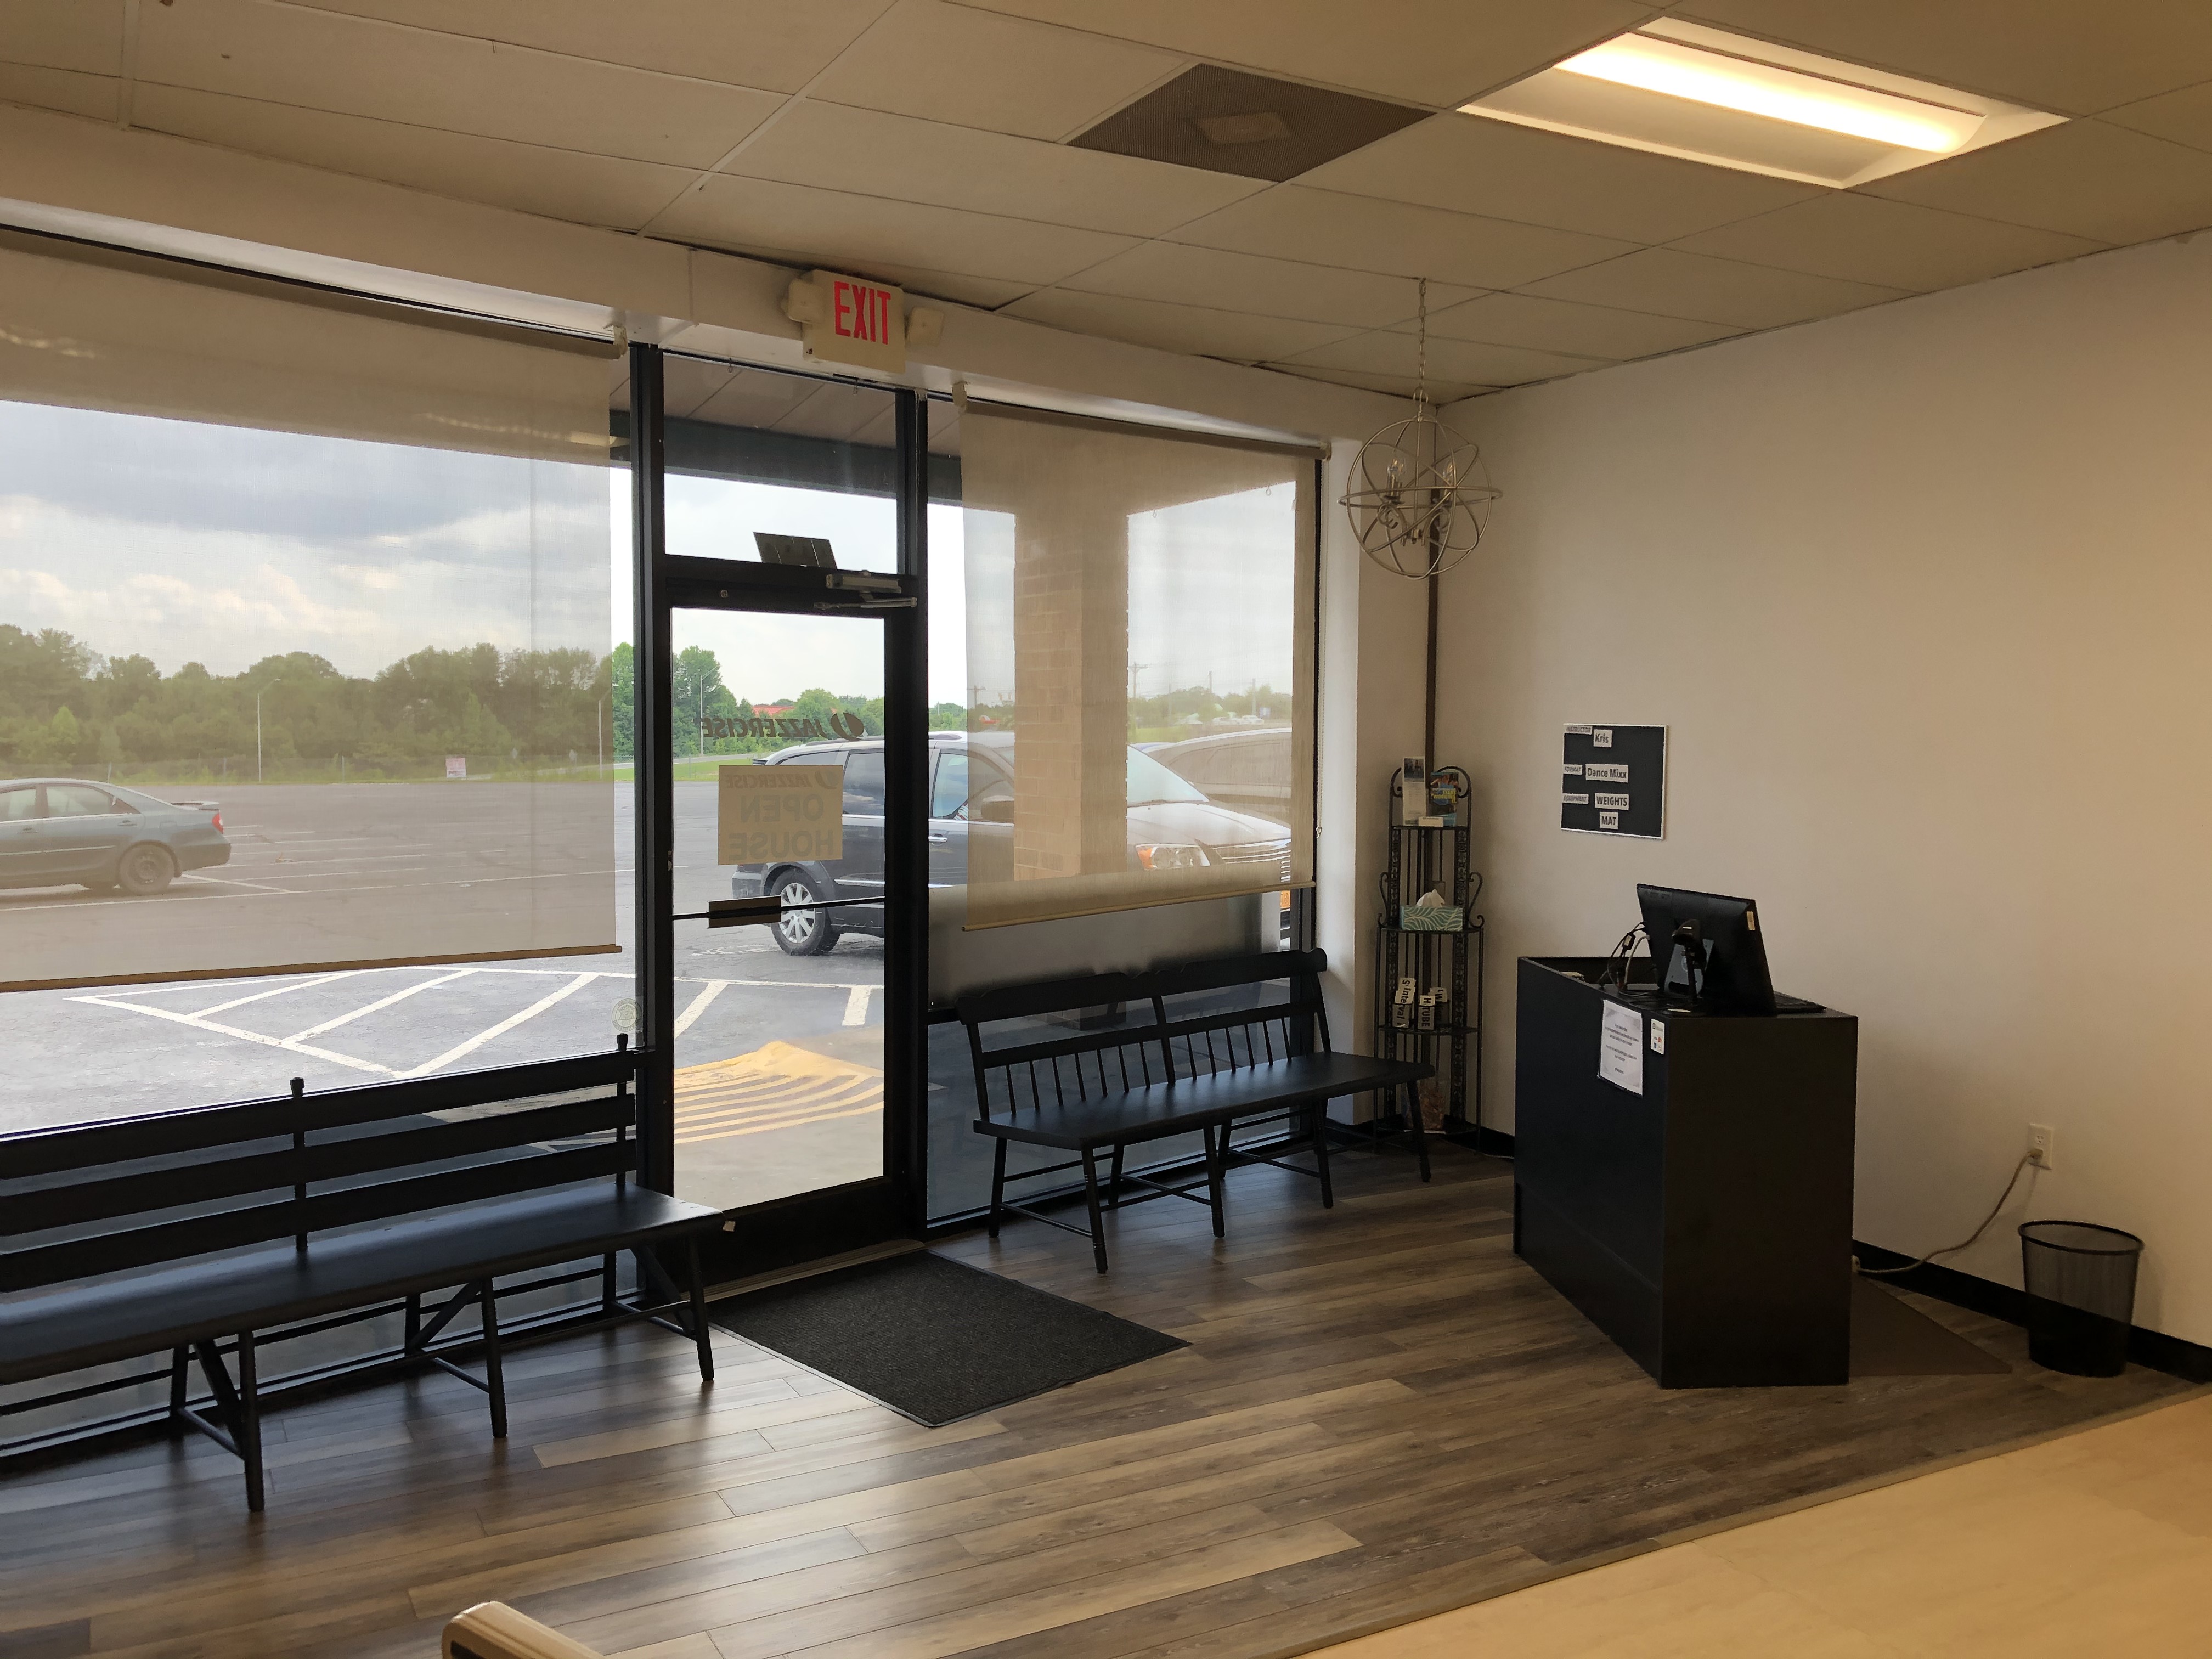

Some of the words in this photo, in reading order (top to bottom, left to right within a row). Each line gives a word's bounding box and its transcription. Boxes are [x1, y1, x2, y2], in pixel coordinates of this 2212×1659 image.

[834, 280, 891, 345] EXIT
[1595, 733, 1609, 744] Kris
[1587, 768, 1608, 777] Dance
[1609, 768, 1627, 779] Mixx
[1596, 795, 1628, 806] WEIGHTS
[1601, 815, 1617, 826] MAT
